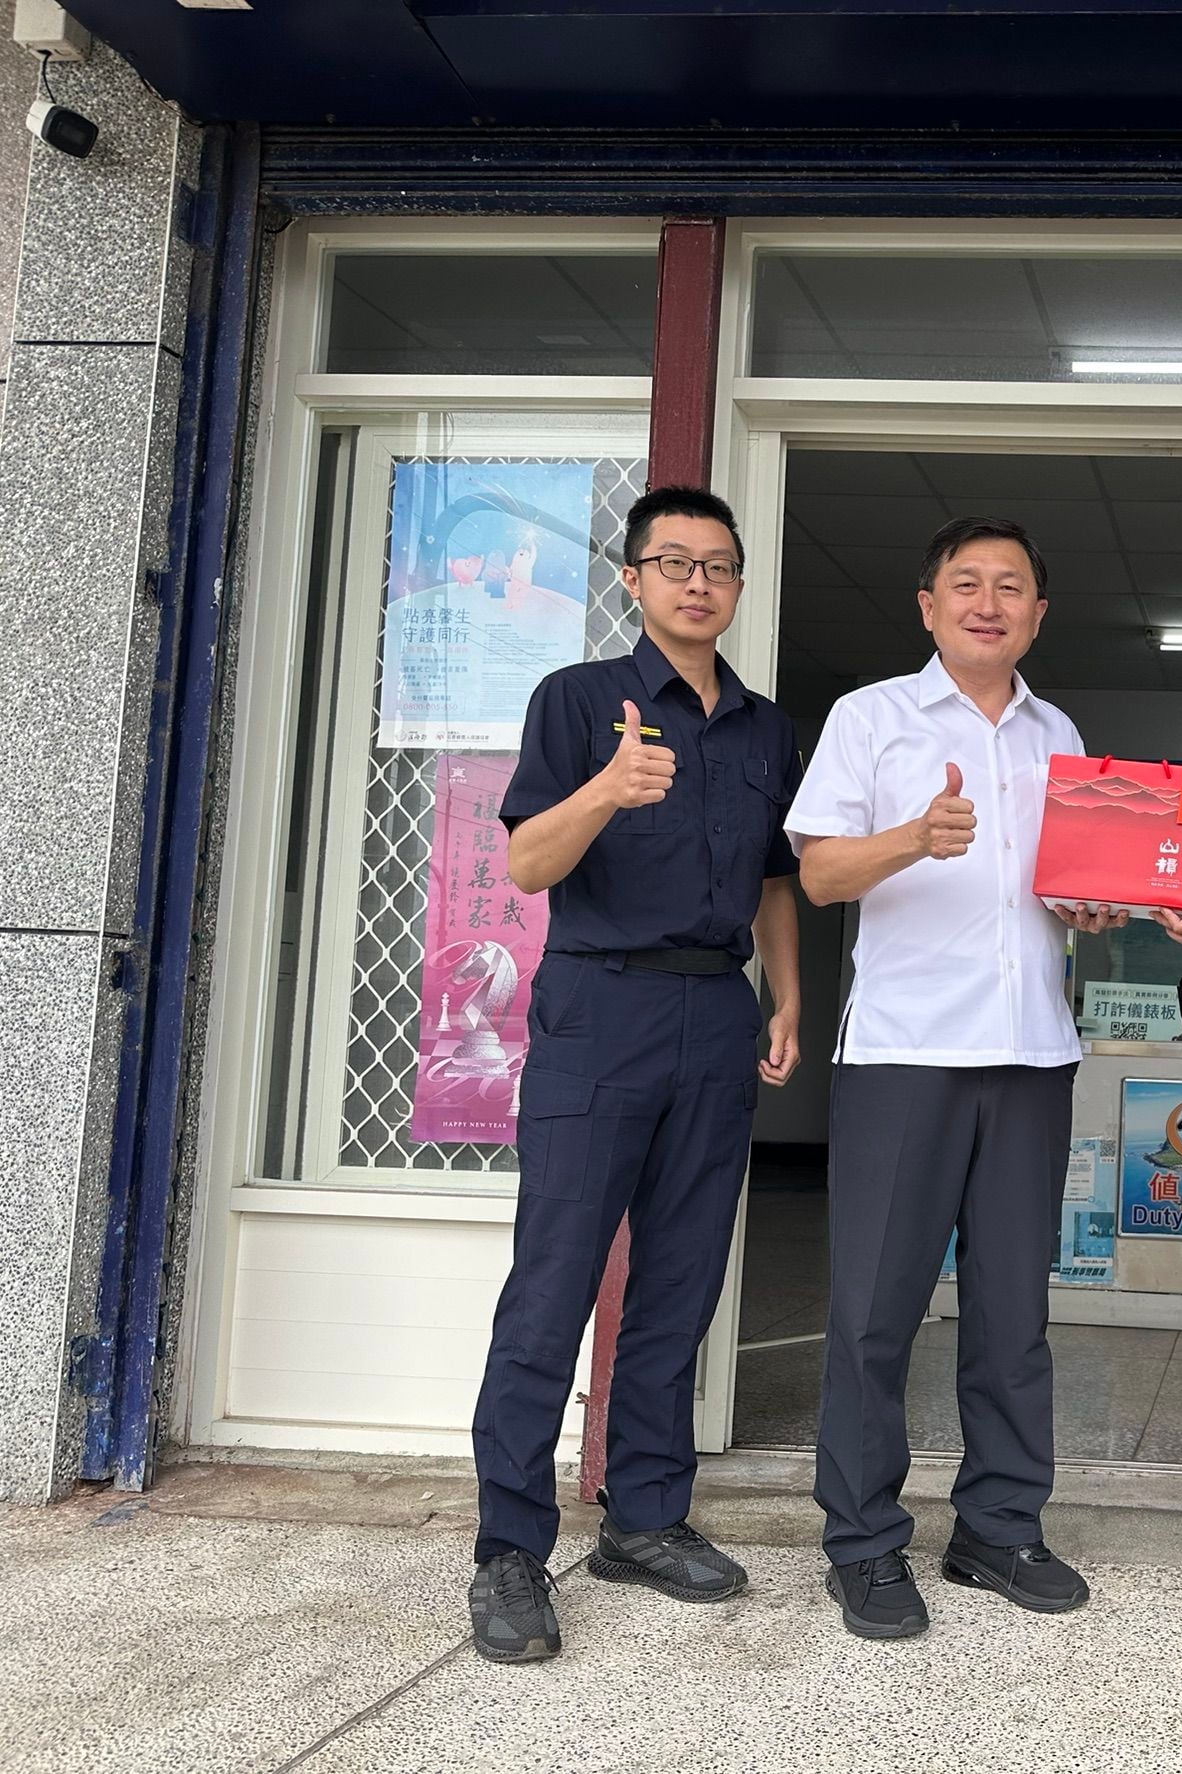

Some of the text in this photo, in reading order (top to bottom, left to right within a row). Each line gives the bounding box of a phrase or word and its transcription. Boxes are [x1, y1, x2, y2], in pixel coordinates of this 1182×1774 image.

[403, 627, 470, 643] 守護同行
[1094, 1001, 1176, 1020] 打詐儀錶板
